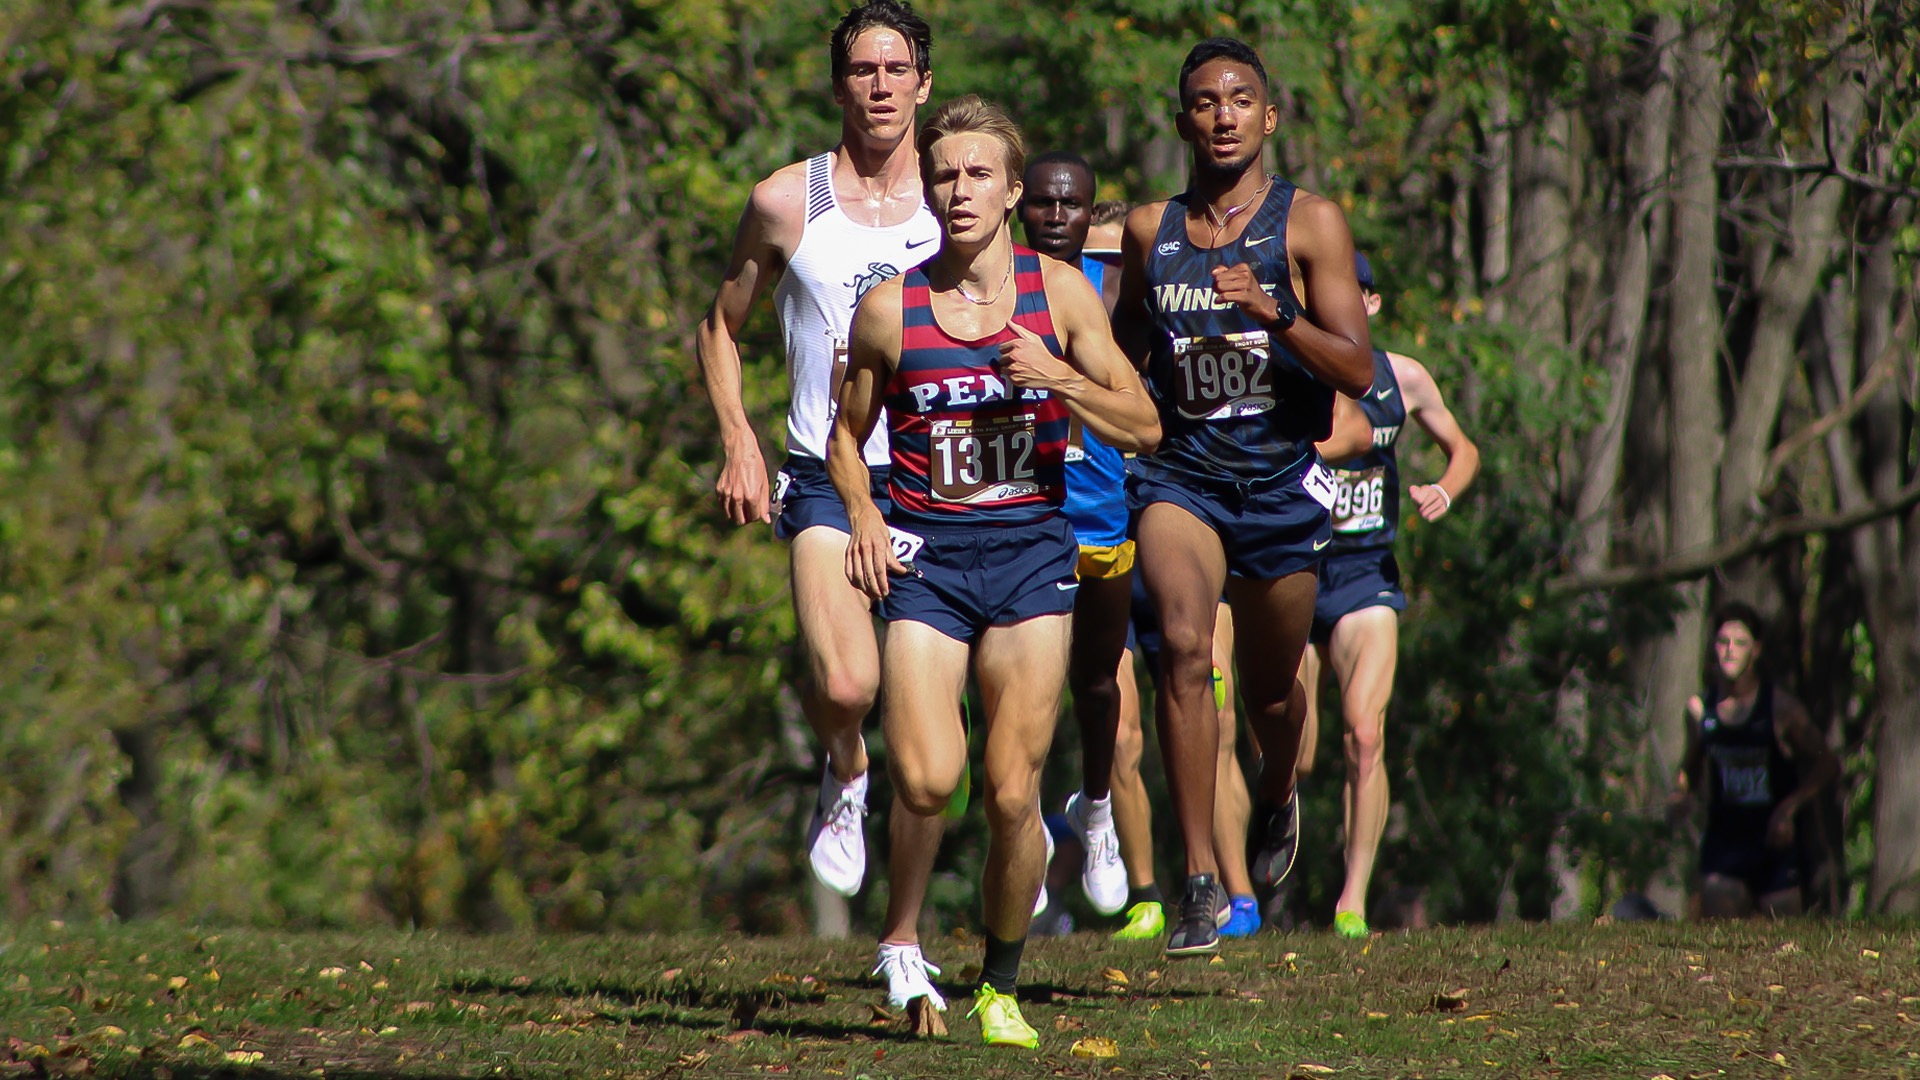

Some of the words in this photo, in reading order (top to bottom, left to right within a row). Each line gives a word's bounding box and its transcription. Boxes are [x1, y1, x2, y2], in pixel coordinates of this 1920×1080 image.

[1161, 241, 1181, 252] SAC
[1178, 348, 1272, 401] 1982
[935, 431, 1034, 486] 1312
